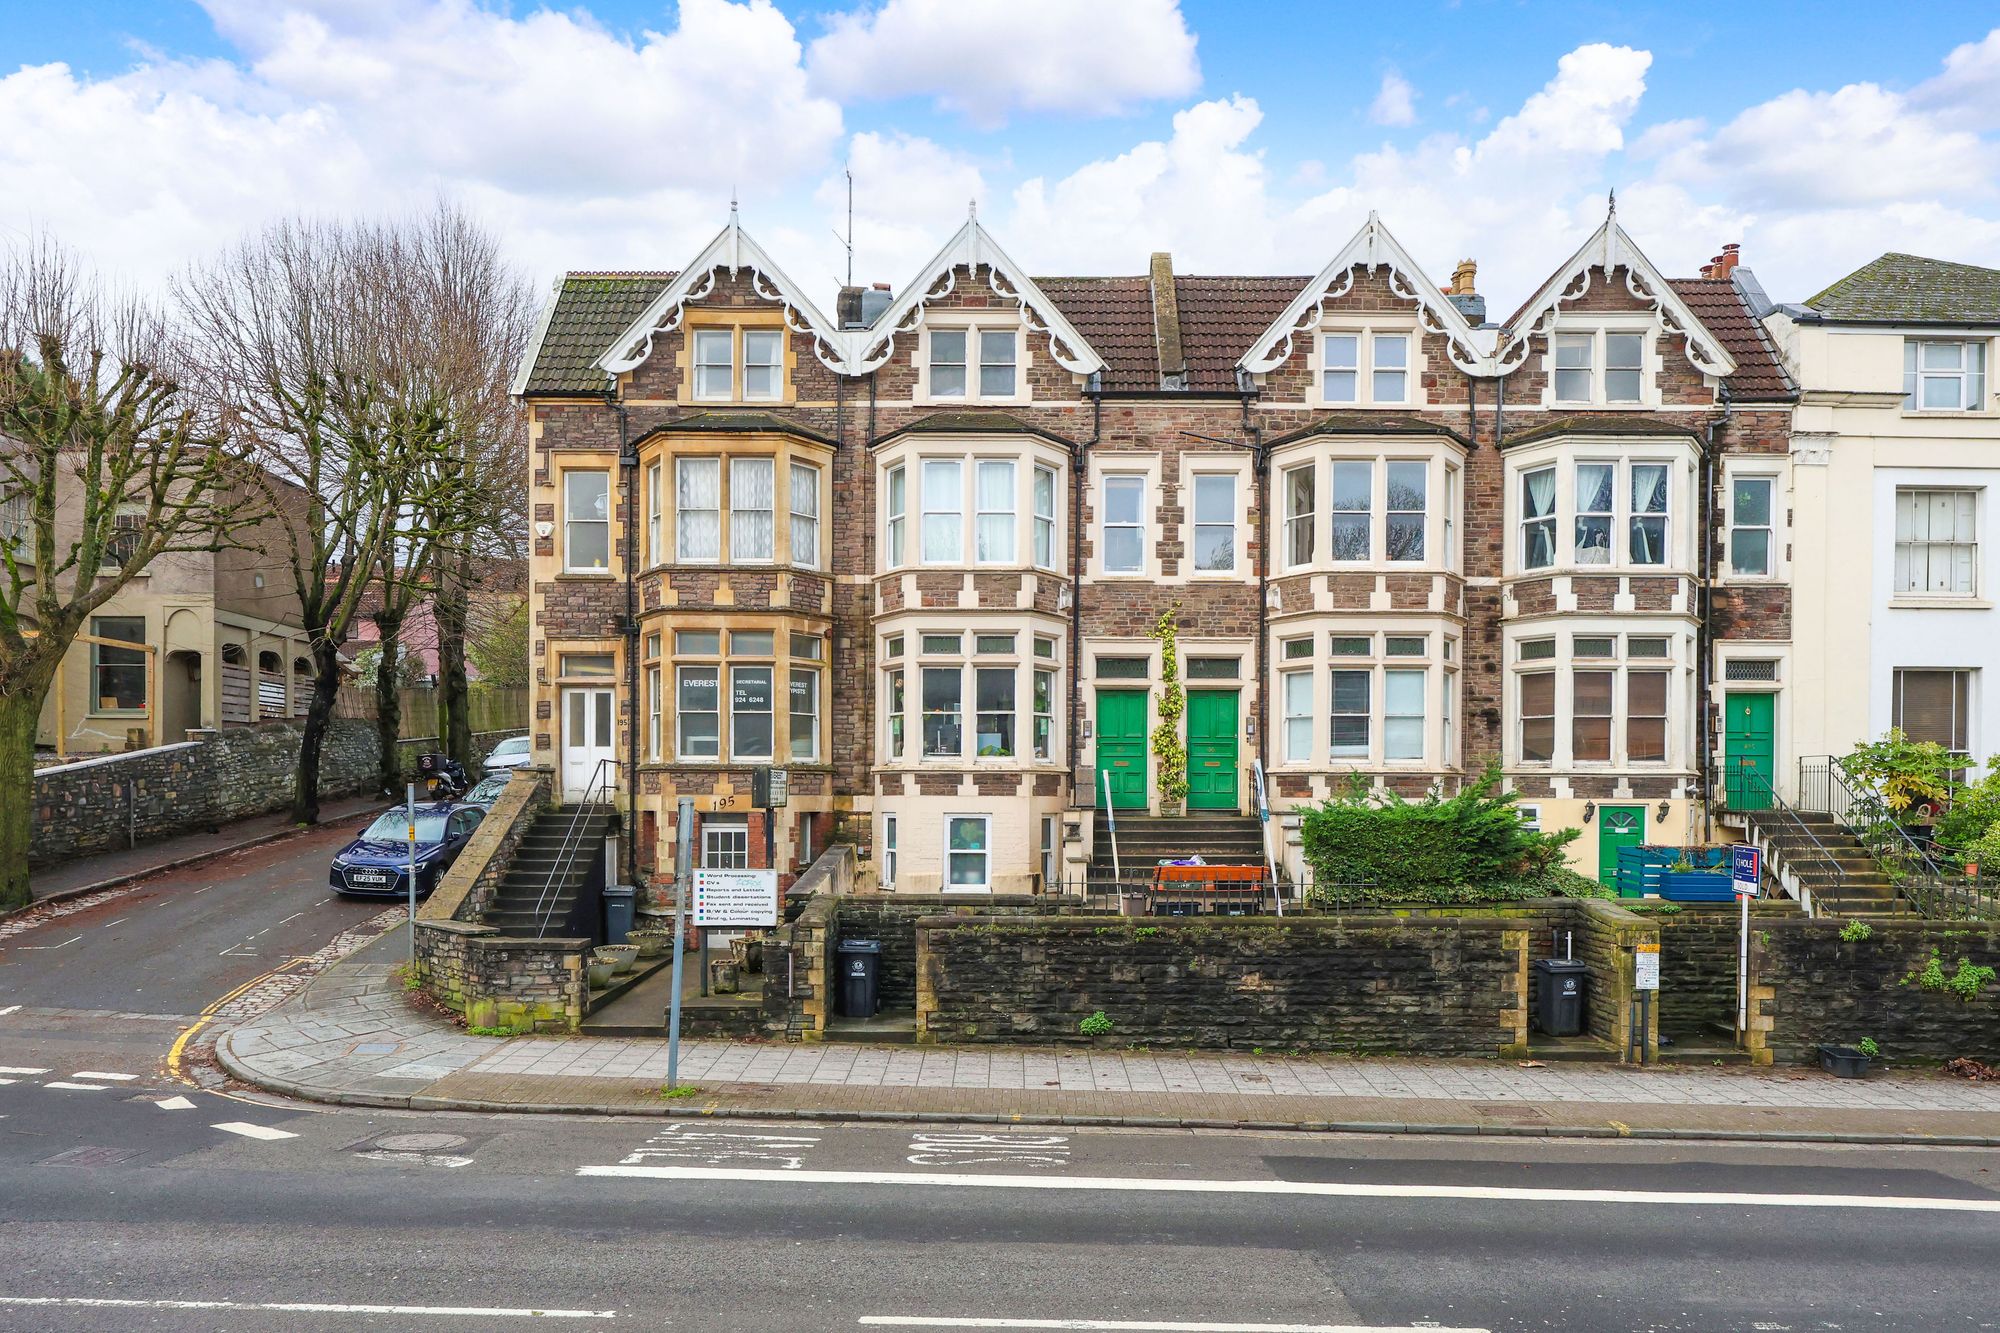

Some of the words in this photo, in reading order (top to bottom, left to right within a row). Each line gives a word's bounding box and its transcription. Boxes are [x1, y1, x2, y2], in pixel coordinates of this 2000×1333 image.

[683, 679, 718, 687] EVEREST
[789, 687, 806, 695] YPISTS
[713, 795, 735, 811] 195
